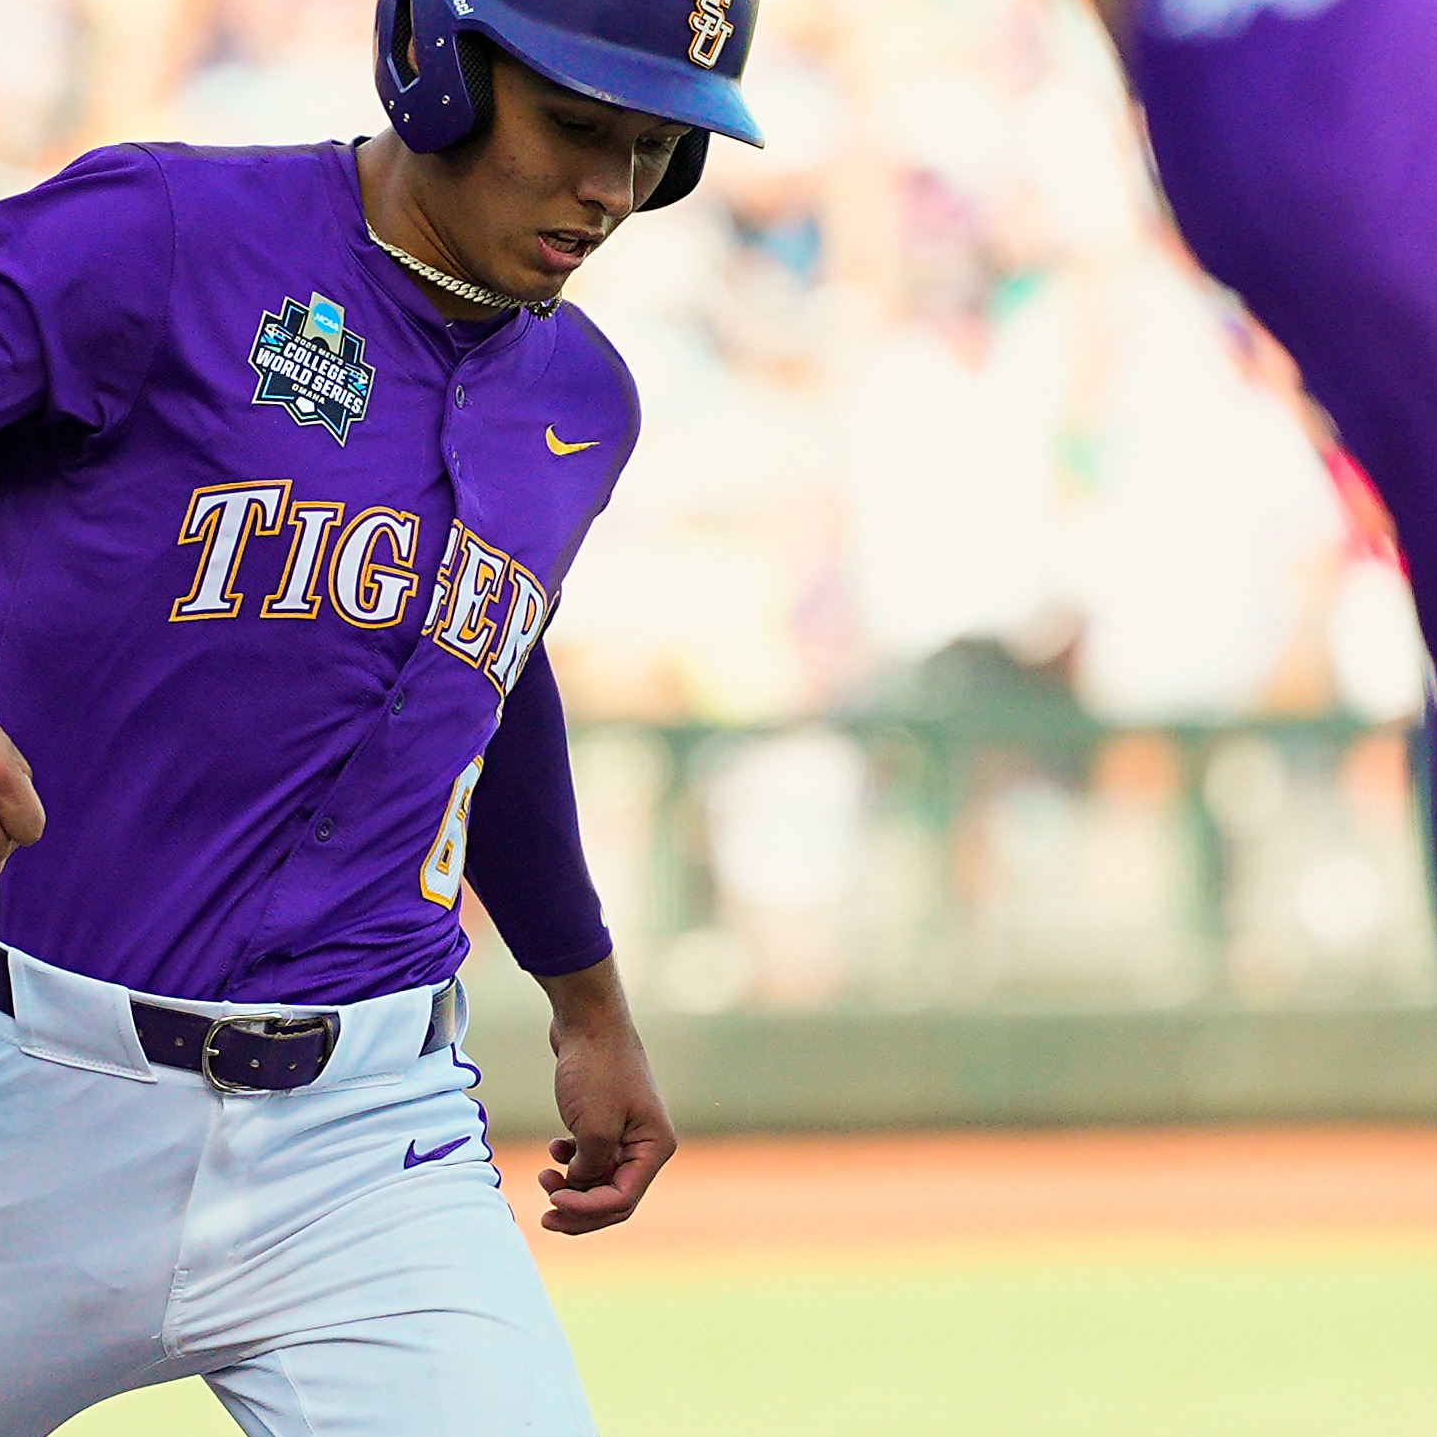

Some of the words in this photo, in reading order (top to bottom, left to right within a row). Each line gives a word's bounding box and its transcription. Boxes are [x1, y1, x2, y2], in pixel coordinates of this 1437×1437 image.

[314, 313, 339, 332] NCAA
[256, 347, 312, 386] WORLD
[312, 375, 364, 414] SERIES
[283, 342, 349, 385] COLLEGE
[291, 384, 326, 405] OMAHA
[168, 479, 554, 701] TIGER
